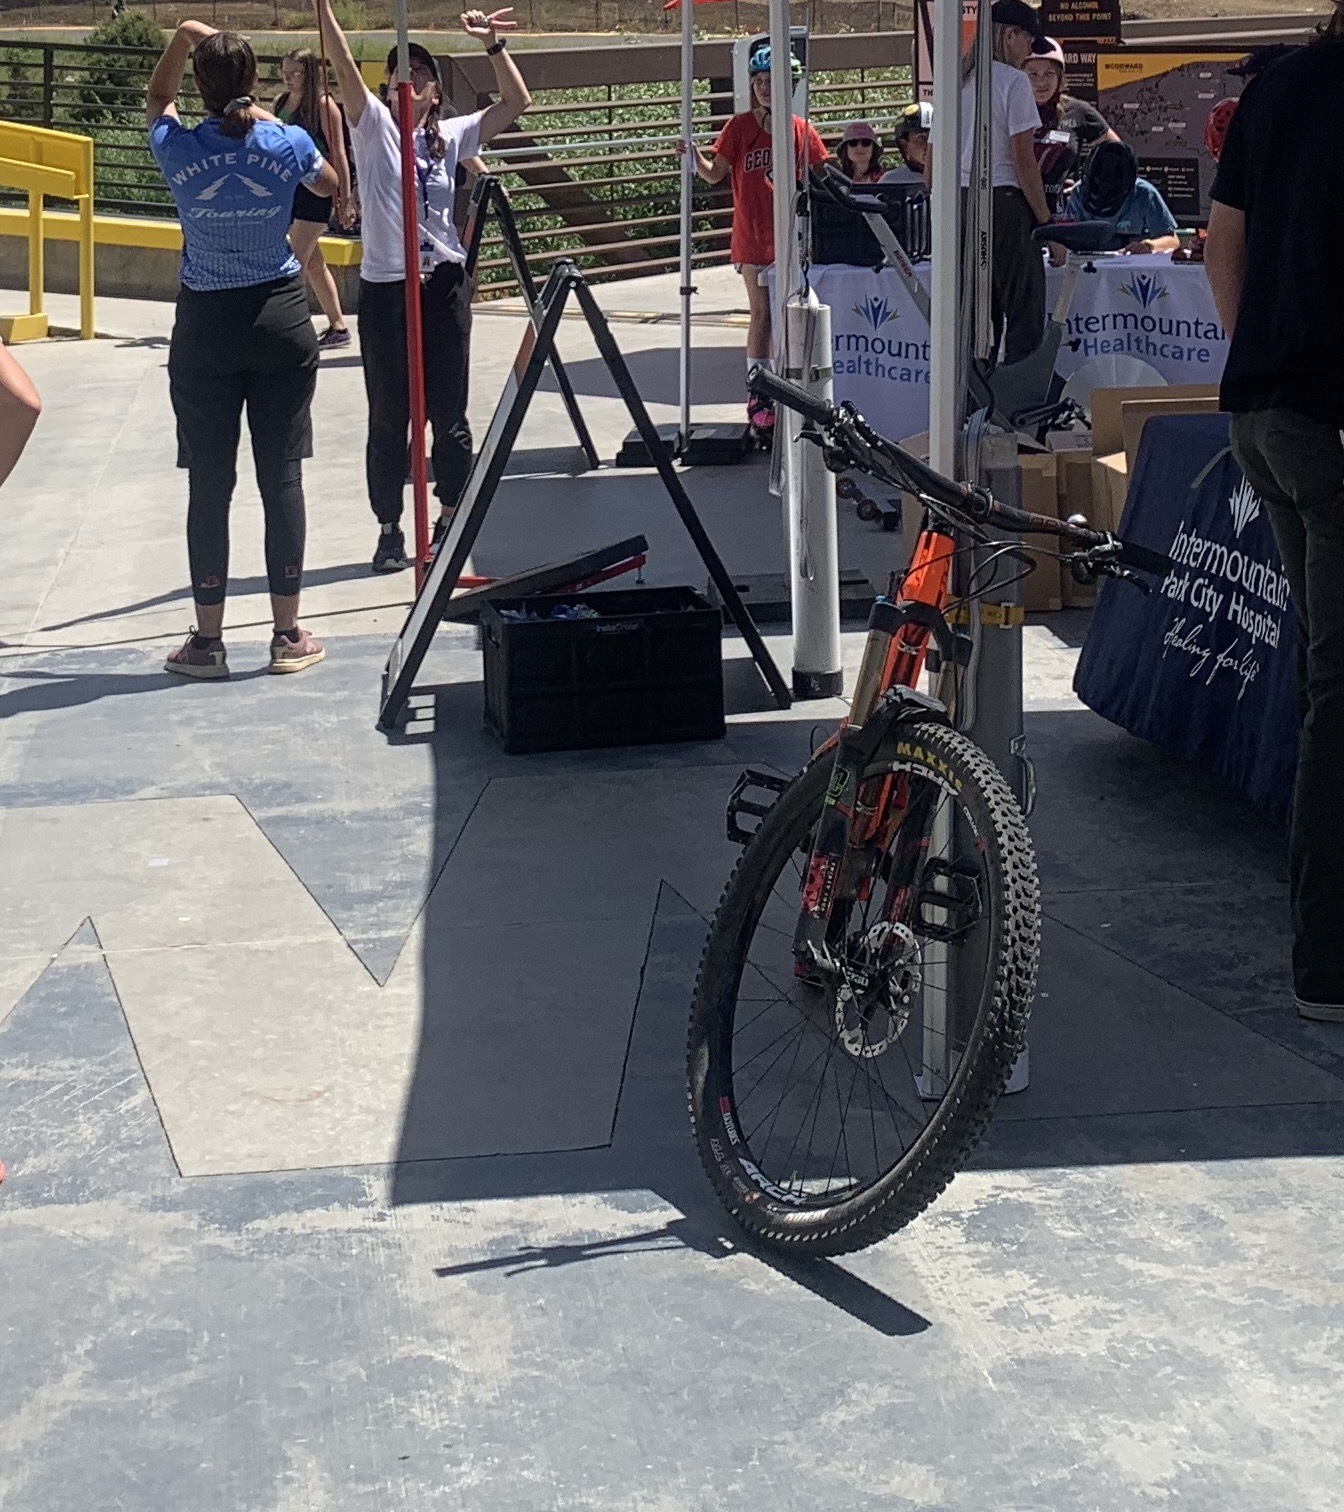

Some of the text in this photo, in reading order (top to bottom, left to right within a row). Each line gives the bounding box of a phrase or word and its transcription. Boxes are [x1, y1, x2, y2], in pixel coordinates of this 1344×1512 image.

[172, 152, 293, 186] WHITE PINE
[744, 148, 771, 173] GEO
[187, 205, 282, 218] Touring
[1083, 332, 1210, 363] Healthcare
[1168, 520, 1291, 612] Intermountain
[1160, 568, 1282, 649] Park City Hospital
[896, 741, 963, 792] MAXXIS
[737, 1156, 808, 1206] ARCH
